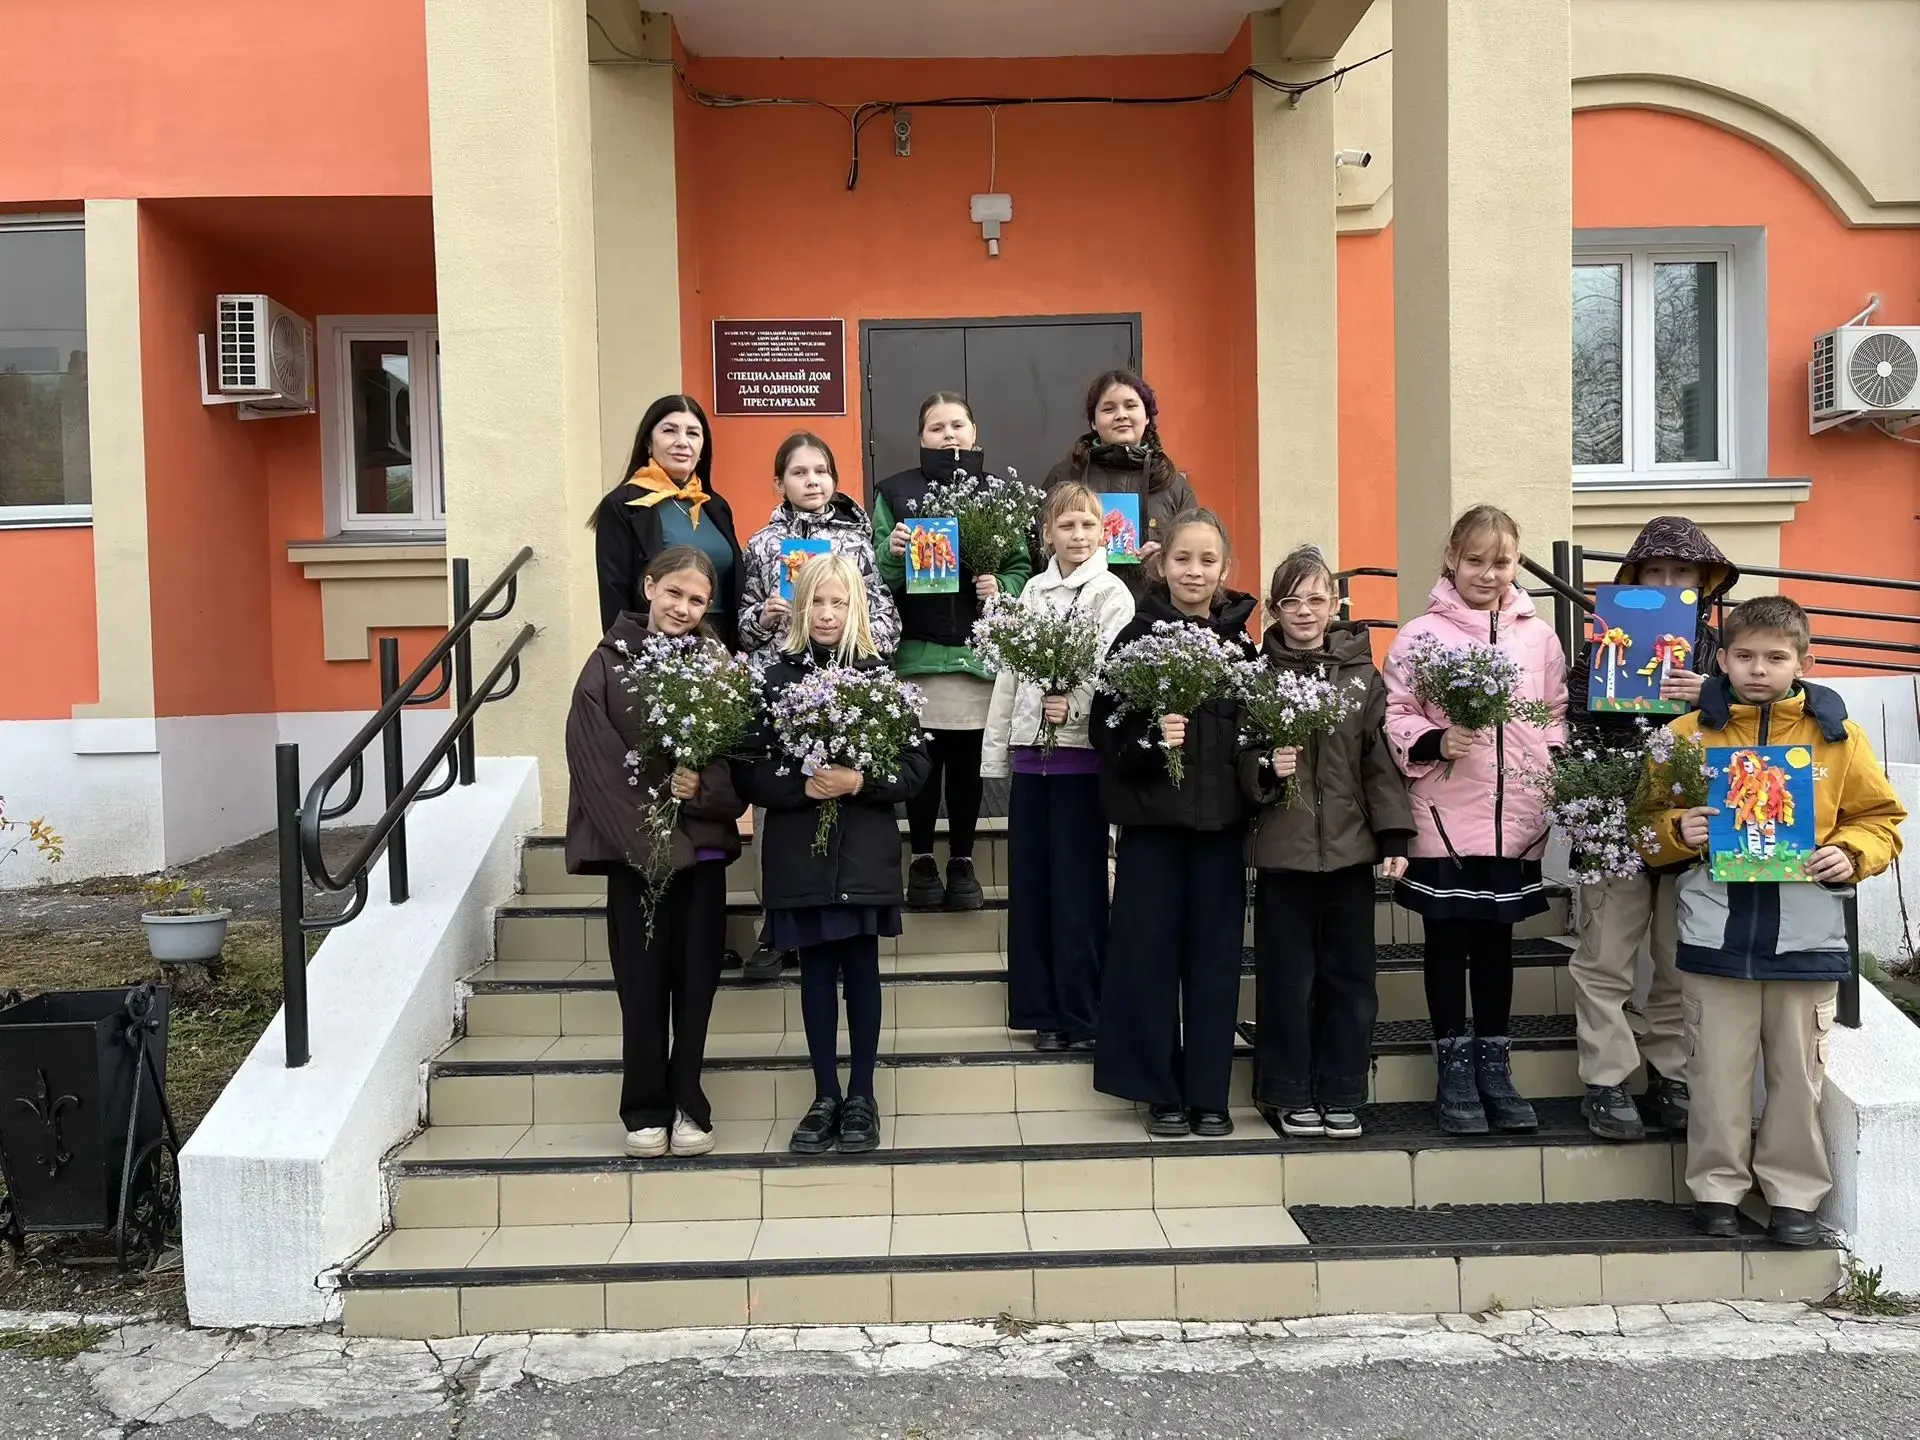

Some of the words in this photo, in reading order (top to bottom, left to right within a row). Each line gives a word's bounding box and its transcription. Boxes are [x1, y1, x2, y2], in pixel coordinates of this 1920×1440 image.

[727, 369, 806, 381] СПЕЦИАЛЬНЫЙ
[809, 371, 831, 382] ДОМ
[738, 385, 760, 395] ДЛЯ
[762, 385, 820, 395] ОДИНОКИХ
[743, 398, 816, 407] ПРЕСТАРЕЛЫХ
